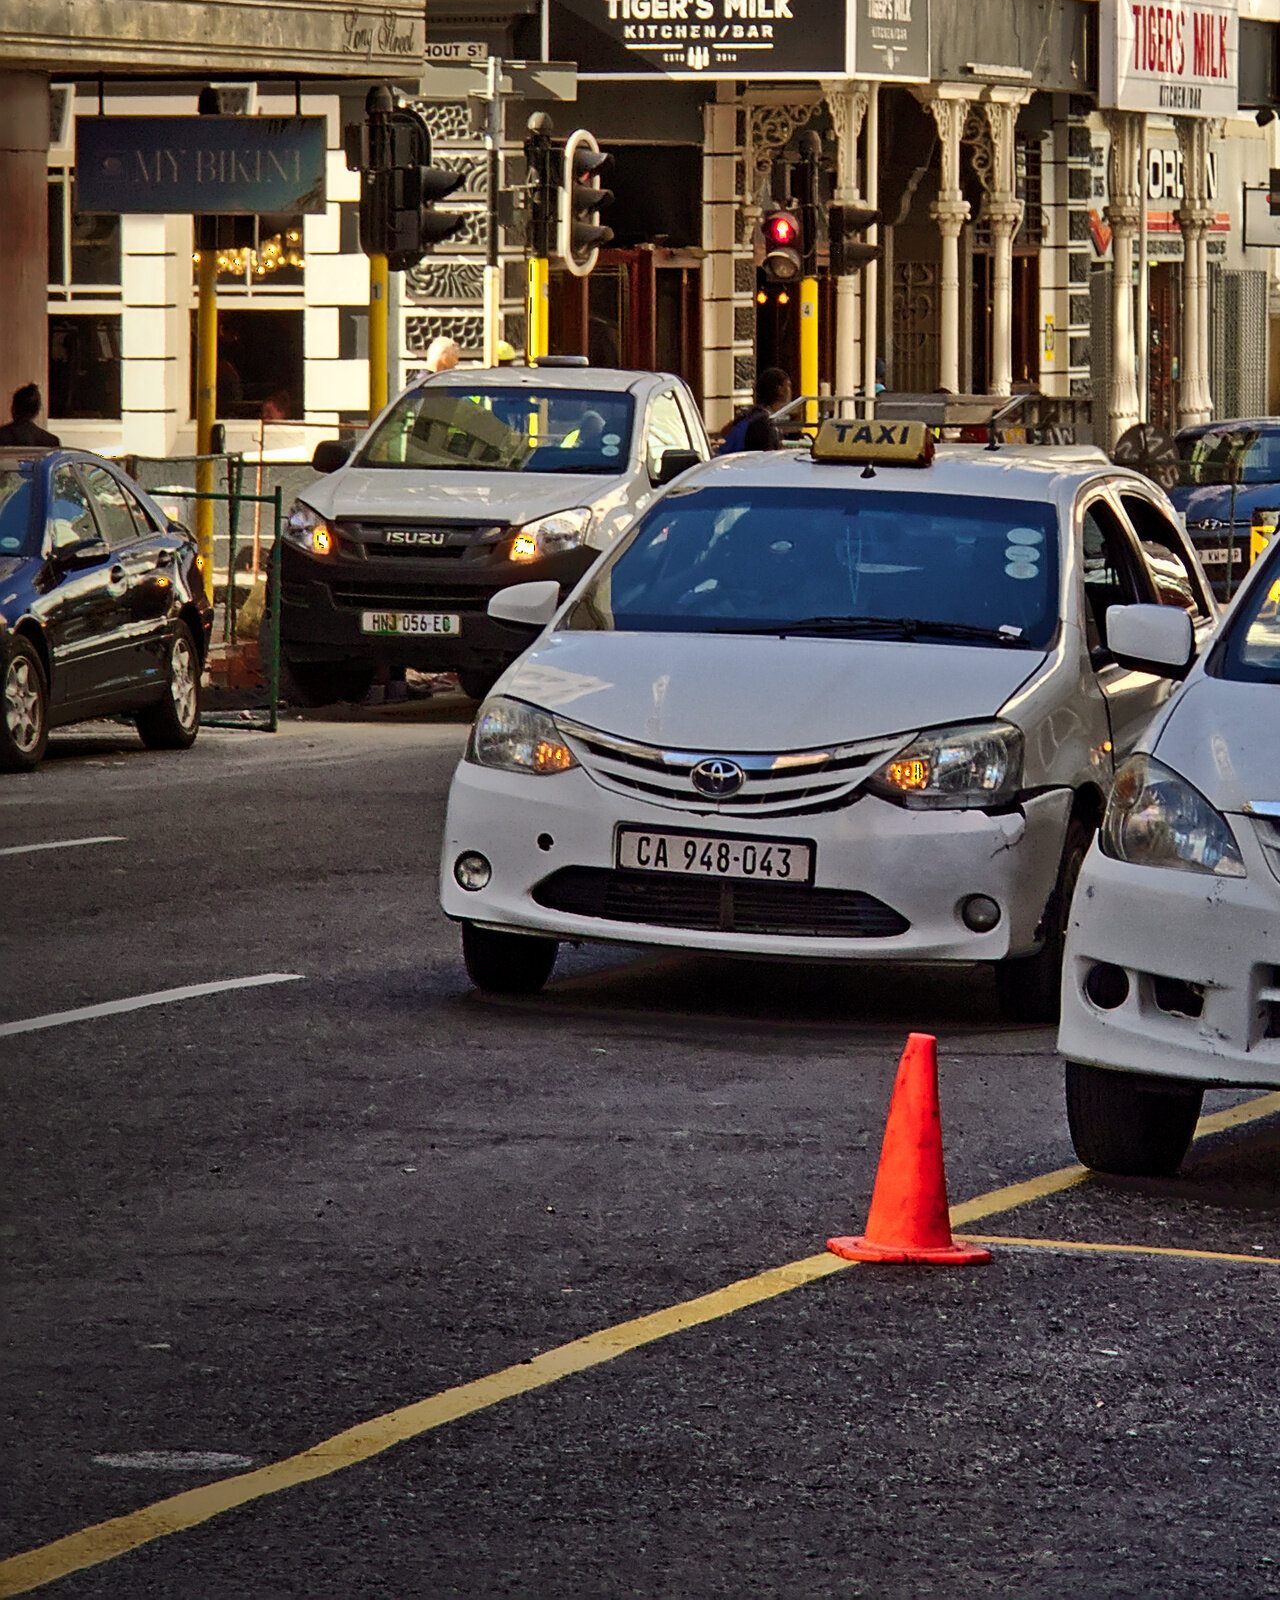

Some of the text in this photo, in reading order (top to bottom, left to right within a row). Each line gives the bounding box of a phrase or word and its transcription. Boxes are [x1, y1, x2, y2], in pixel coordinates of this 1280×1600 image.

[624, 25, 774, 39] KITCHEN/BAR
[1193, 12, 1228, 79] MILK
[133, 150, 301, 183] MY BIKINI
[833, 423, 910, 445] TAXI
[386, 531, 445, 545] ISUZU
[372, 614, 397, 631] HNJ
[402, 614, 428, 632] 056
[637, 836, 792, 878] CA 948-043
